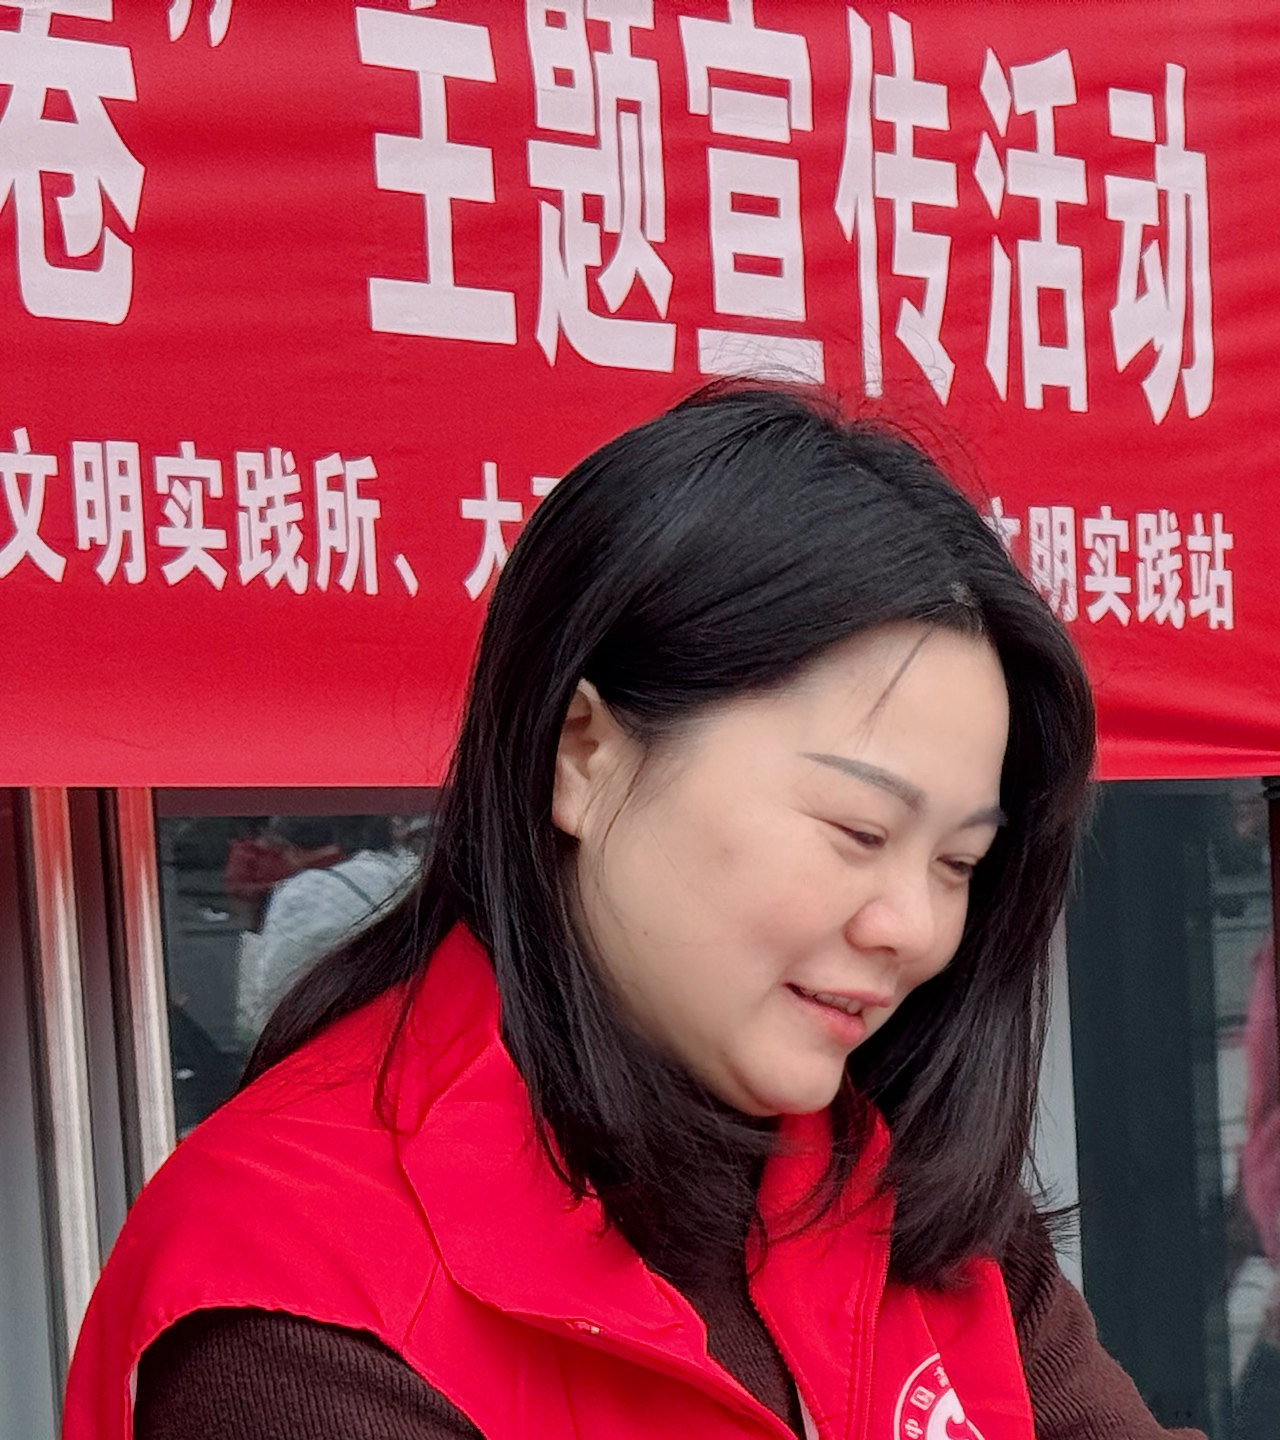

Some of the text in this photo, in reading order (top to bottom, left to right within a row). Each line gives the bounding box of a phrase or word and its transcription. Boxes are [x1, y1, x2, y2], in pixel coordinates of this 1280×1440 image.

[0, 427, 562, 600] 文明实践所、大
